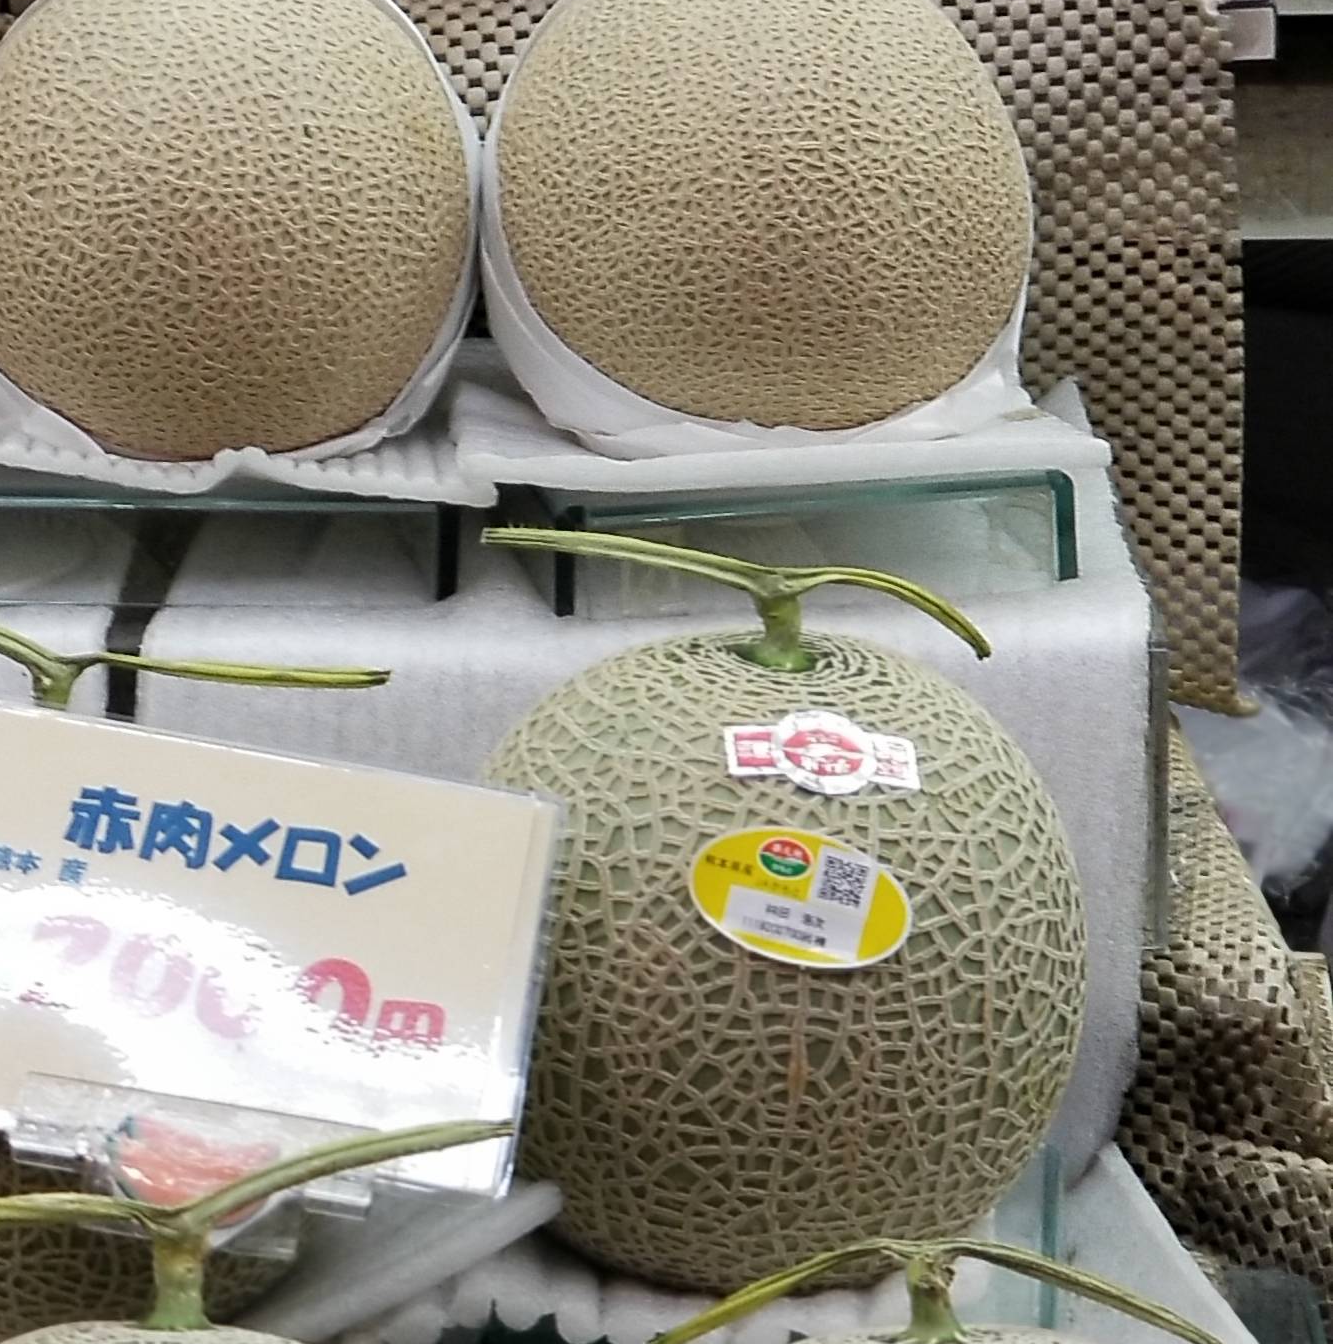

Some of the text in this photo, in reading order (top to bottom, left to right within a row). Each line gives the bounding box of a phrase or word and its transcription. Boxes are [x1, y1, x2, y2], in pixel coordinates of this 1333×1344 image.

[64, 785, 408, 896] 赤肉メロン
